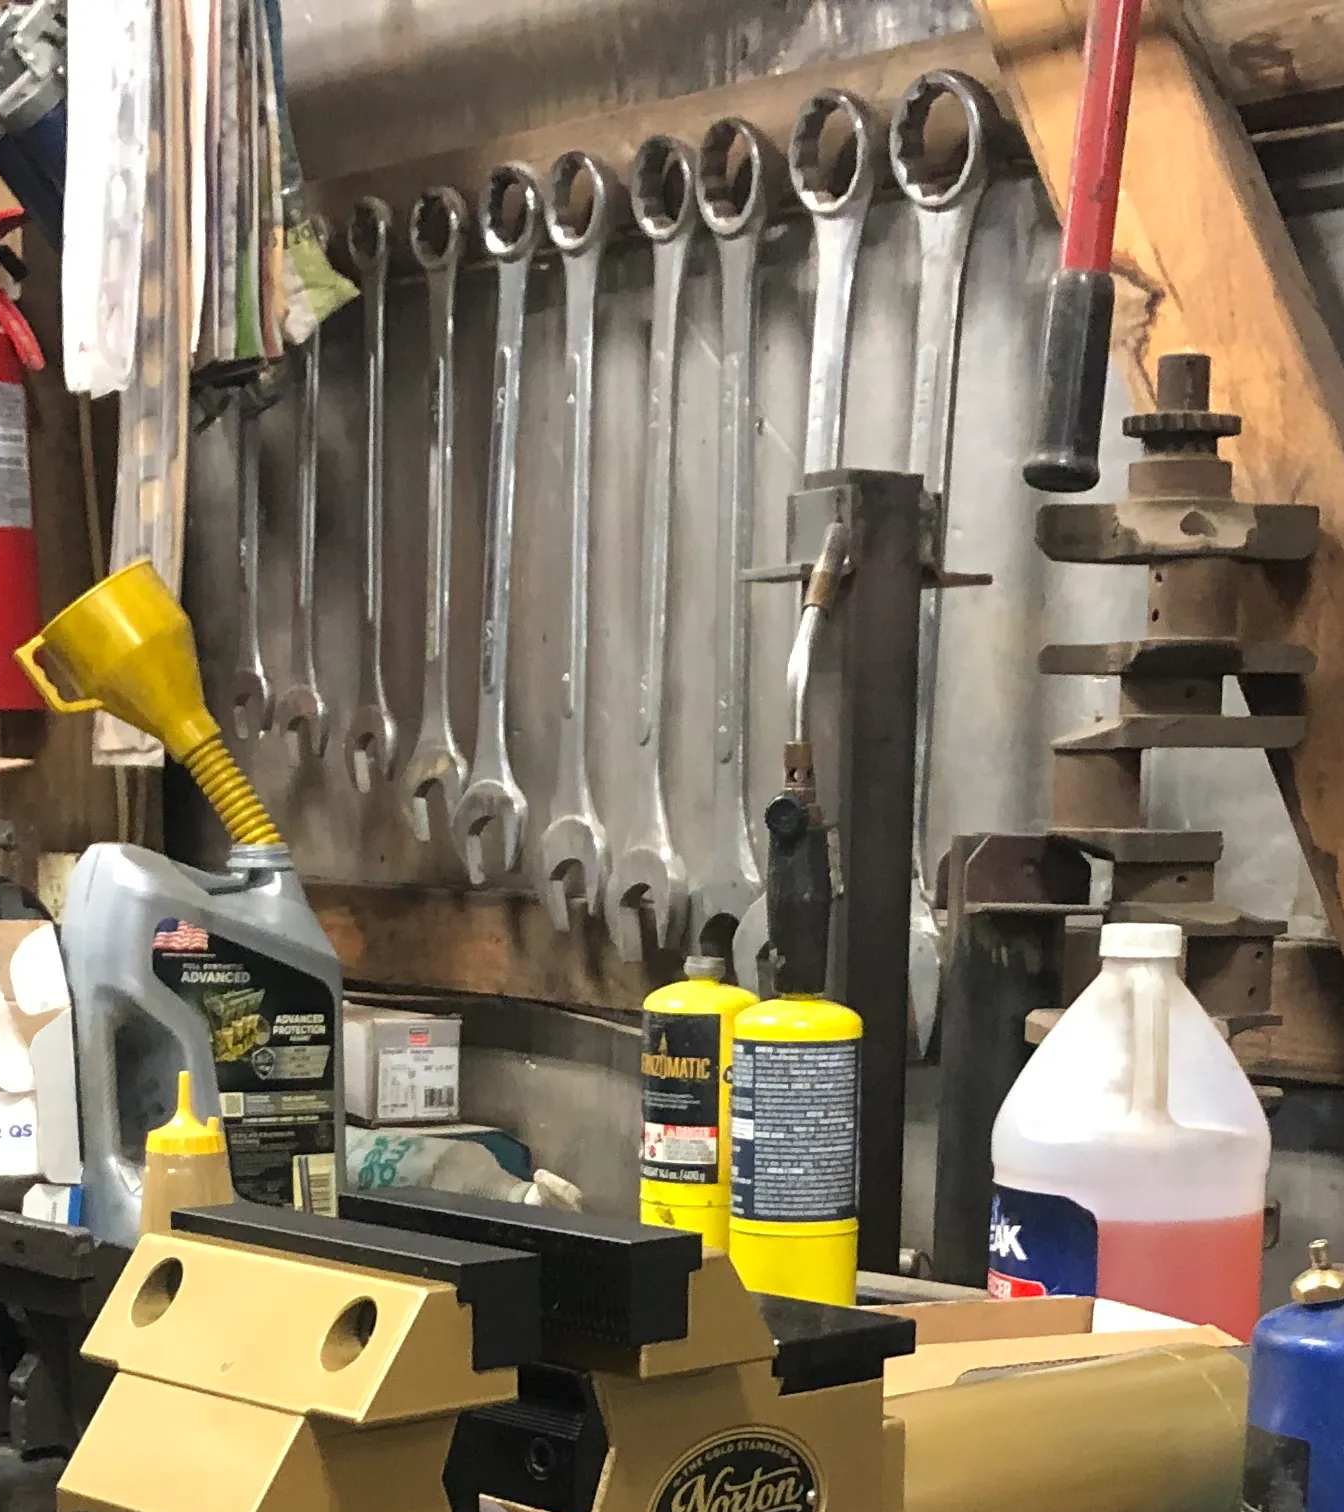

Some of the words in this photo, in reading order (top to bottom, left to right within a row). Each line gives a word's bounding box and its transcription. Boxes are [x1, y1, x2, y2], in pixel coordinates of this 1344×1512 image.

[181, 971, 251, 984] ADVANCED
[275, 1013, 325, 1025] ADVANCED
[272, 1025, 326, 1036] PROTECTION
[9, 1123, 33, 1138] QS
[989, 1225, 1028, 1261] EAK
[682, 1459, 704, 1478] THE
[706, 1444, 735, 1461] GOLD
[736, 1440, 791, 1460] STANDARD
